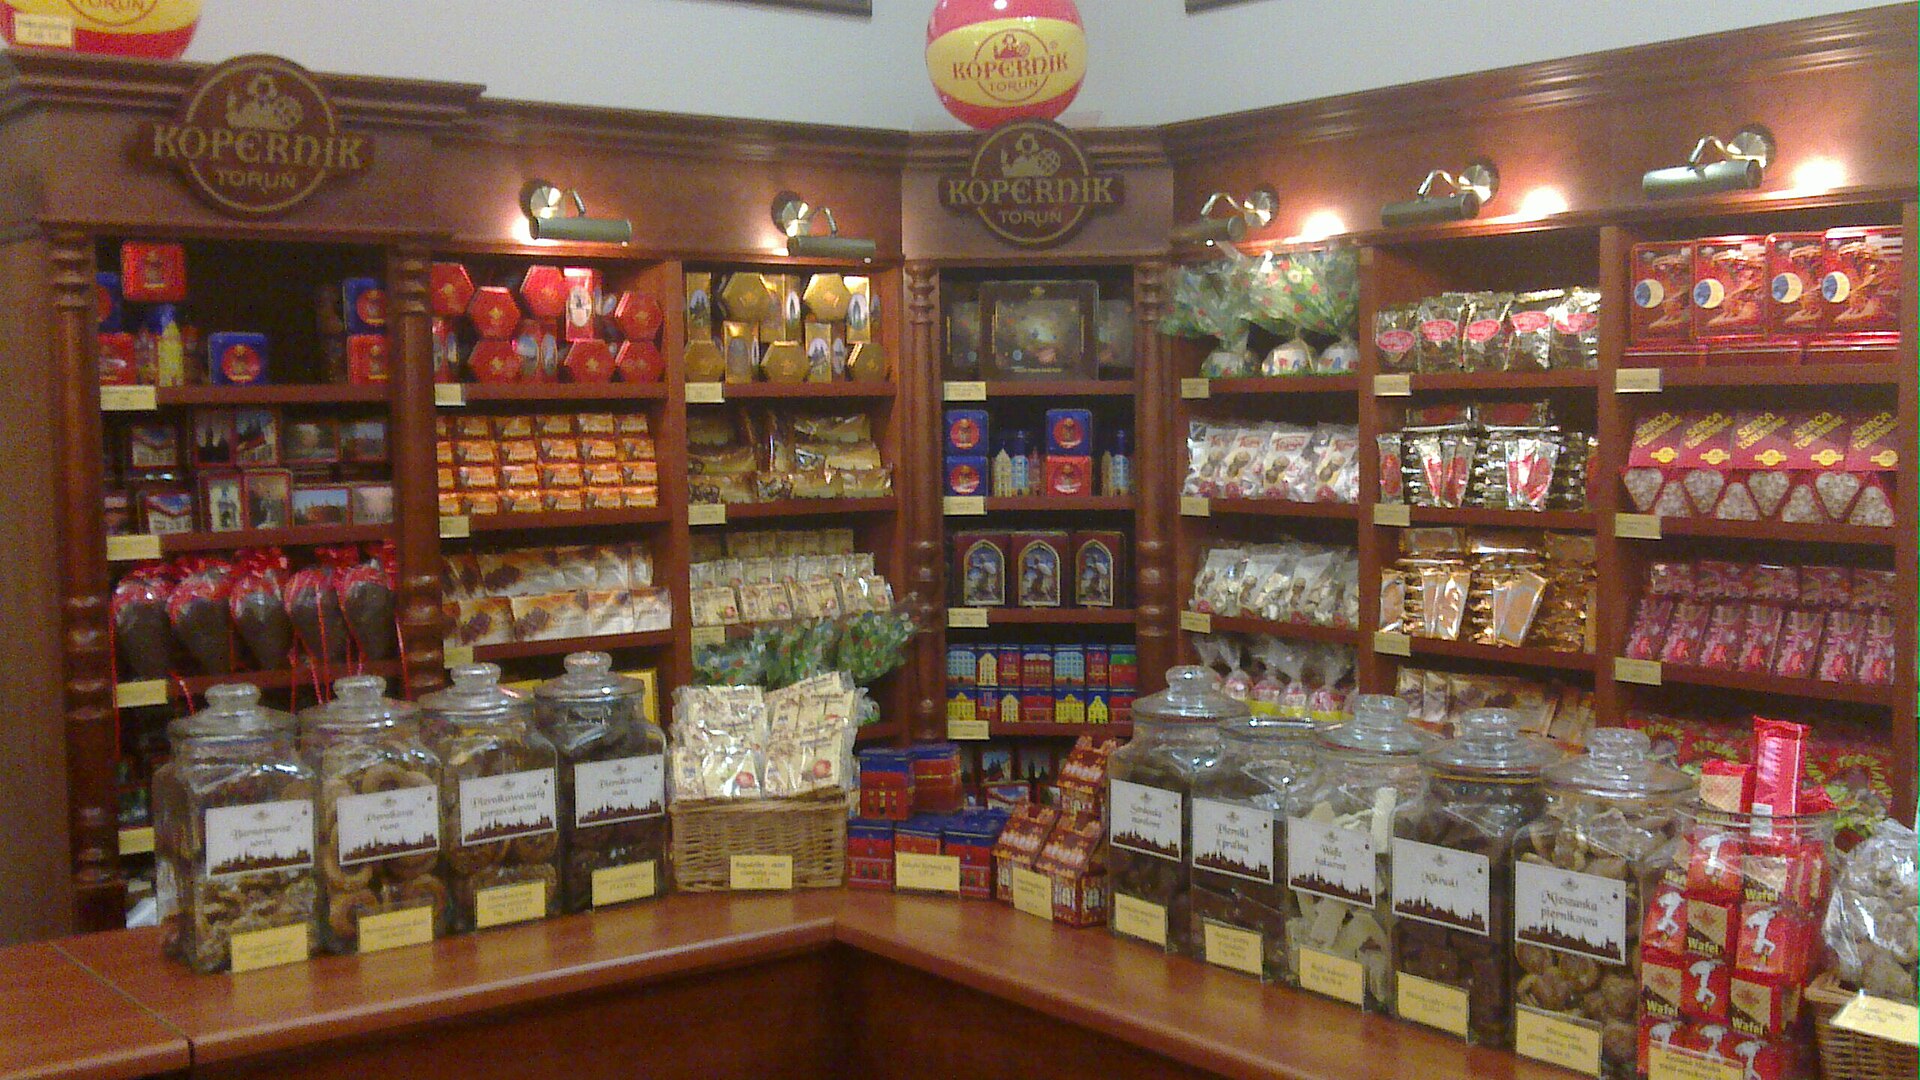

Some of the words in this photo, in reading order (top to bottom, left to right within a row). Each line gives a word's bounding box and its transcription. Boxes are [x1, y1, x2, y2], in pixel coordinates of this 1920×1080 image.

[952, 52, 1069, 81] KOPERNIK
[153, 124, 364, 170] KOPERNIK
[949, 176, 1115, 205] KOPERNIK
[1635, 411, 1671, 438] SERCA
[1686, 411, 1723, 438] SERCA
[1737, 411, 1775, 438] SERCA
[1793, 411, 1832, 438] SERCA
[1853, 411, 1892, 439] SERCA
[1541, 890, 1598, 911] Mieszanka
[1541, 906, 1598, 927] piernikowa
[1688, 936, 1720, 954] Wafel
[1647, 999, 1679, 1016] Wafel
[1732, 1015, 1765, 1034] Wafel
